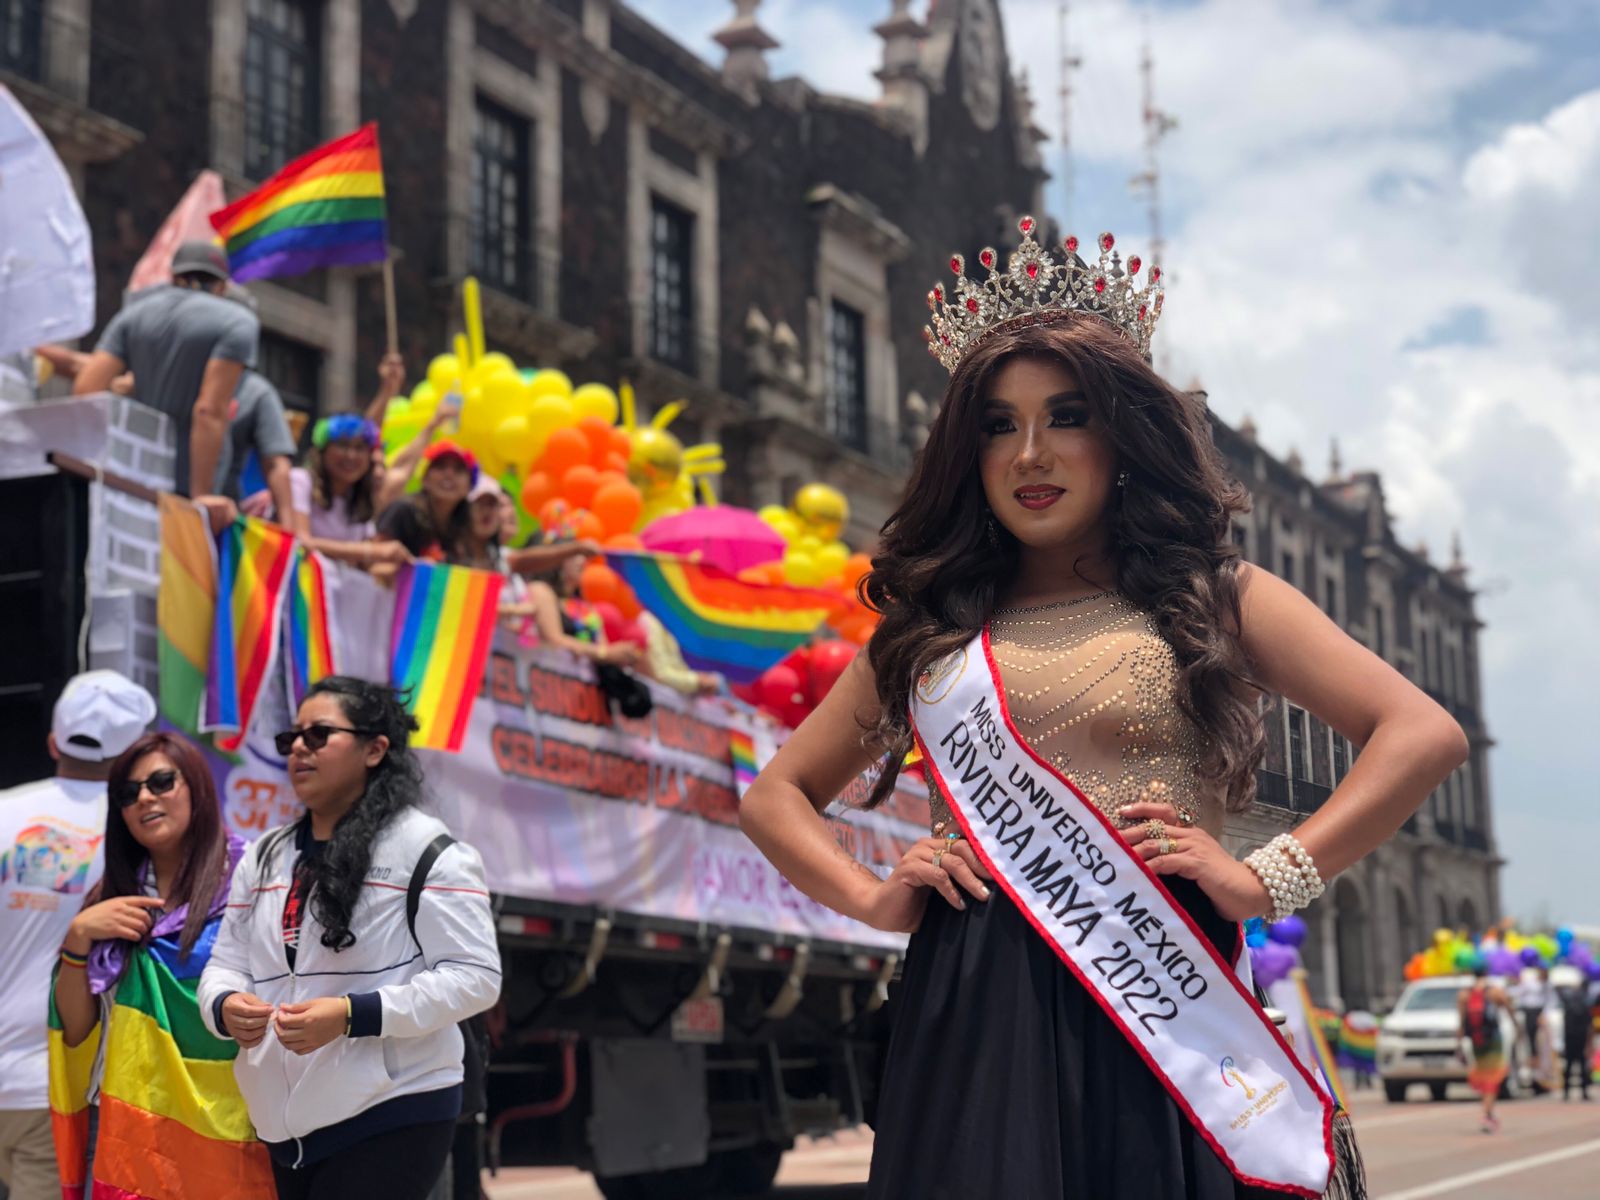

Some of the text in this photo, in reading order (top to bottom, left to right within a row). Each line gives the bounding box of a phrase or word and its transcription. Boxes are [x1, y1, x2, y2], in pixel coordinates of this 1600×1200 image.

[940, 720, 1035, 861] RIVIERA
[1020, 846, 1103, 946] MAYA
[1091, 940, 1179, 1037] 2022
[970, 696, 1208, 1001] MISS UNIVERSO MÉXICO
